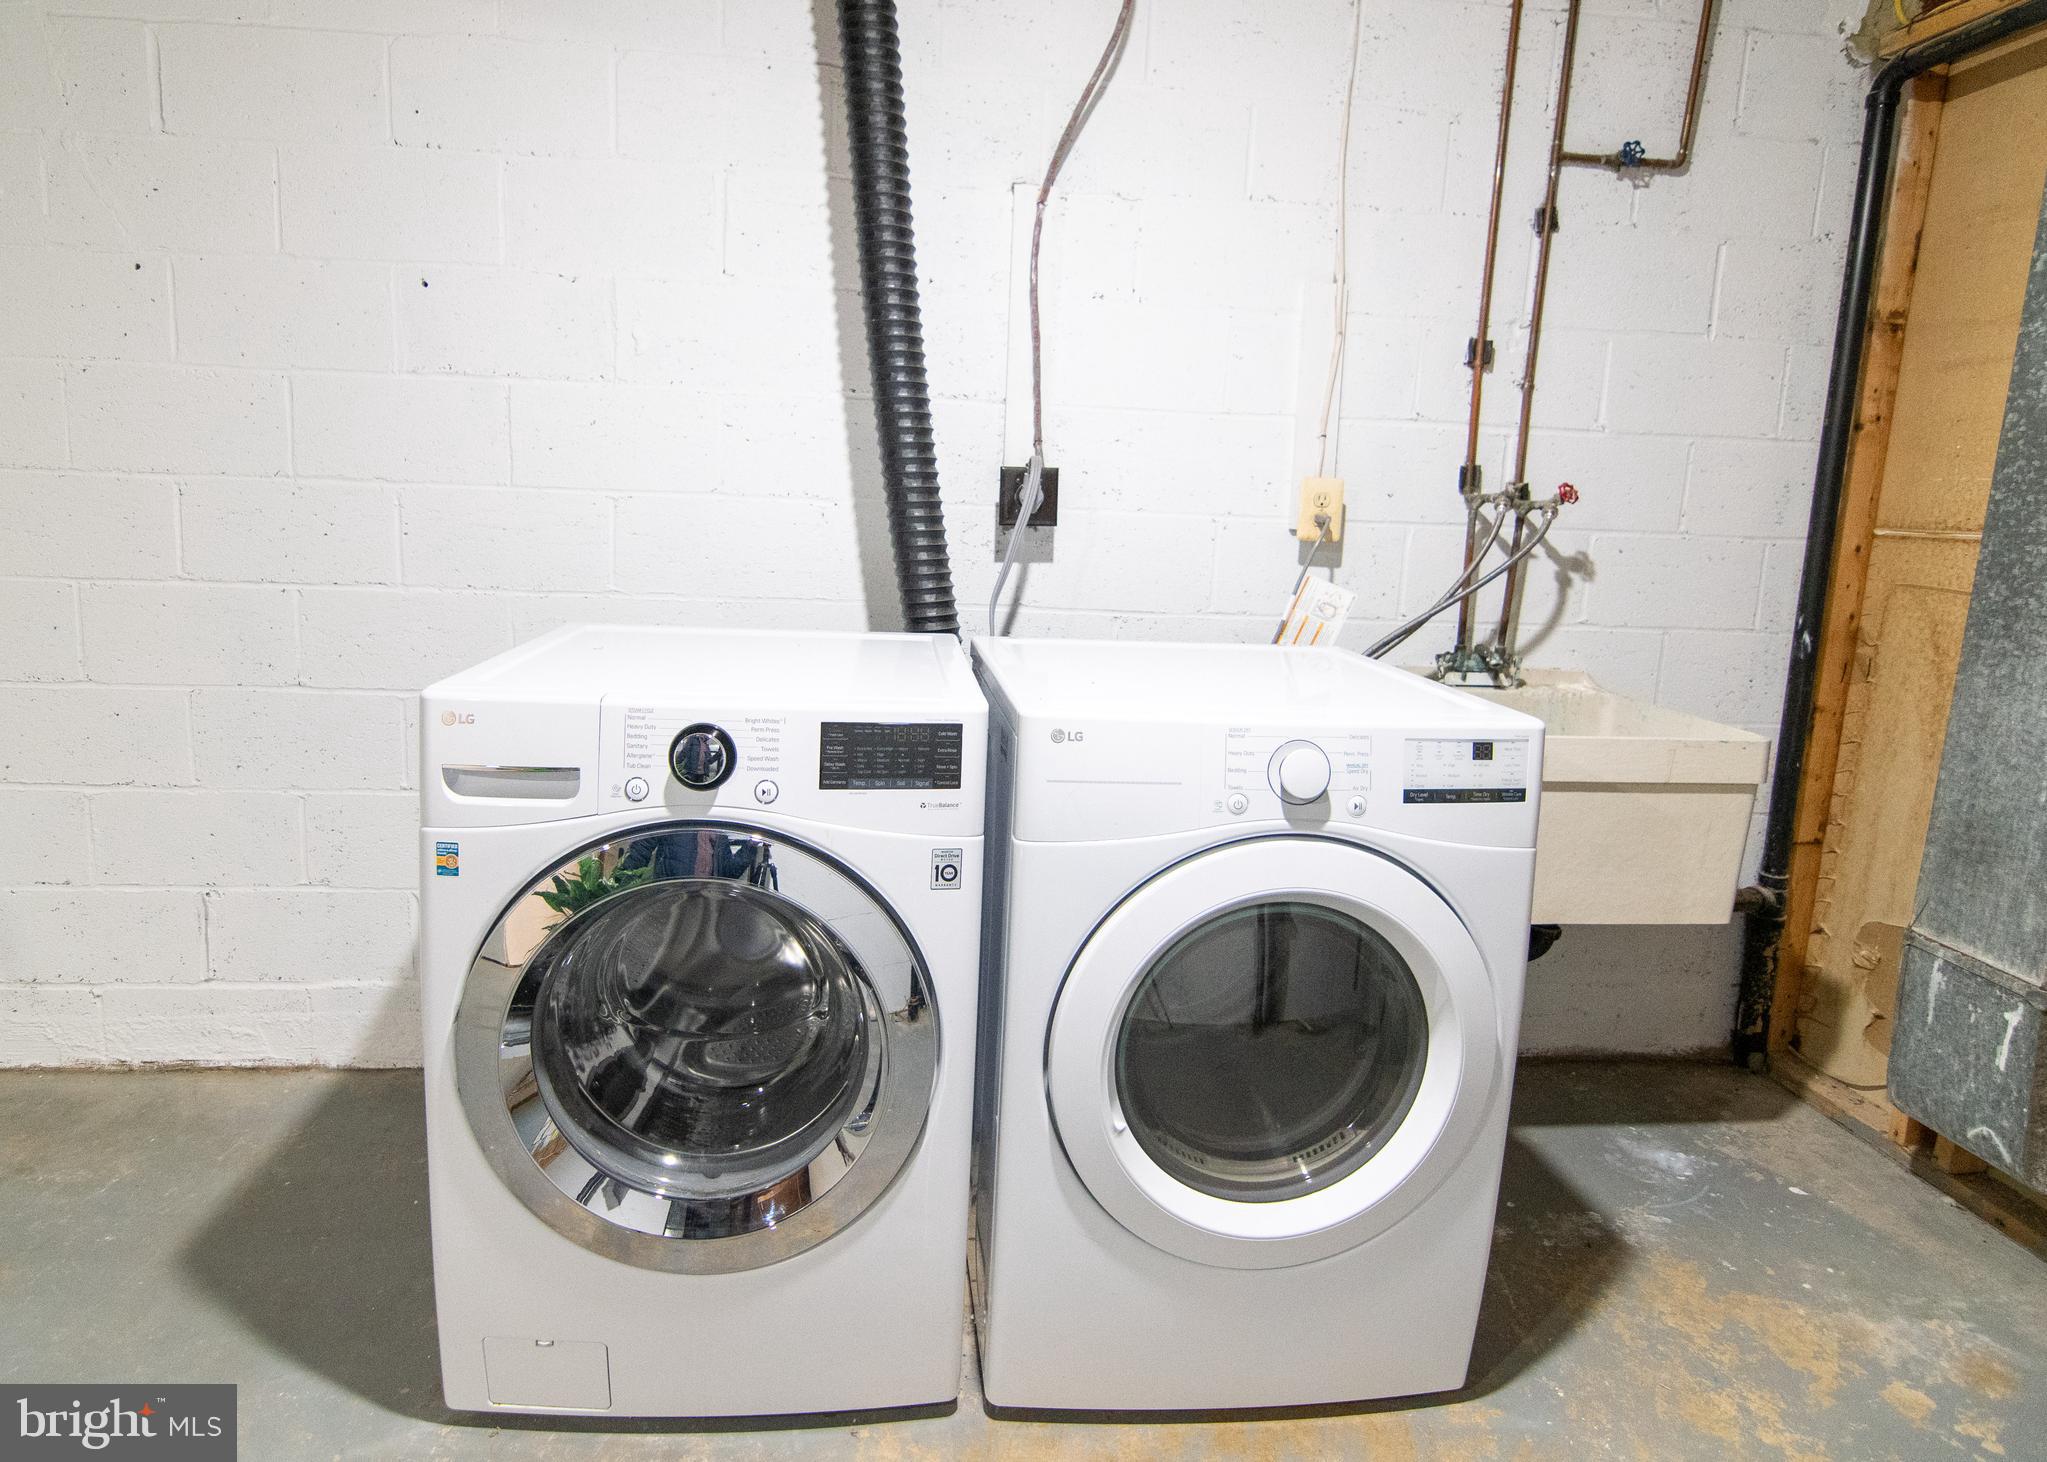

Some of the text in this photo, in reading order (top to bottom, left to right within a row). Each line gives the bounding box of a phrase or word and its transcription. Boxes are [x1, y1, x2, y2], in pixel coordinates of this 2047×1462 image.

[458, 713, 475, 724] LG
[1068, 731, 1084, 742] LG
[934, 863, 958, 882] 10
